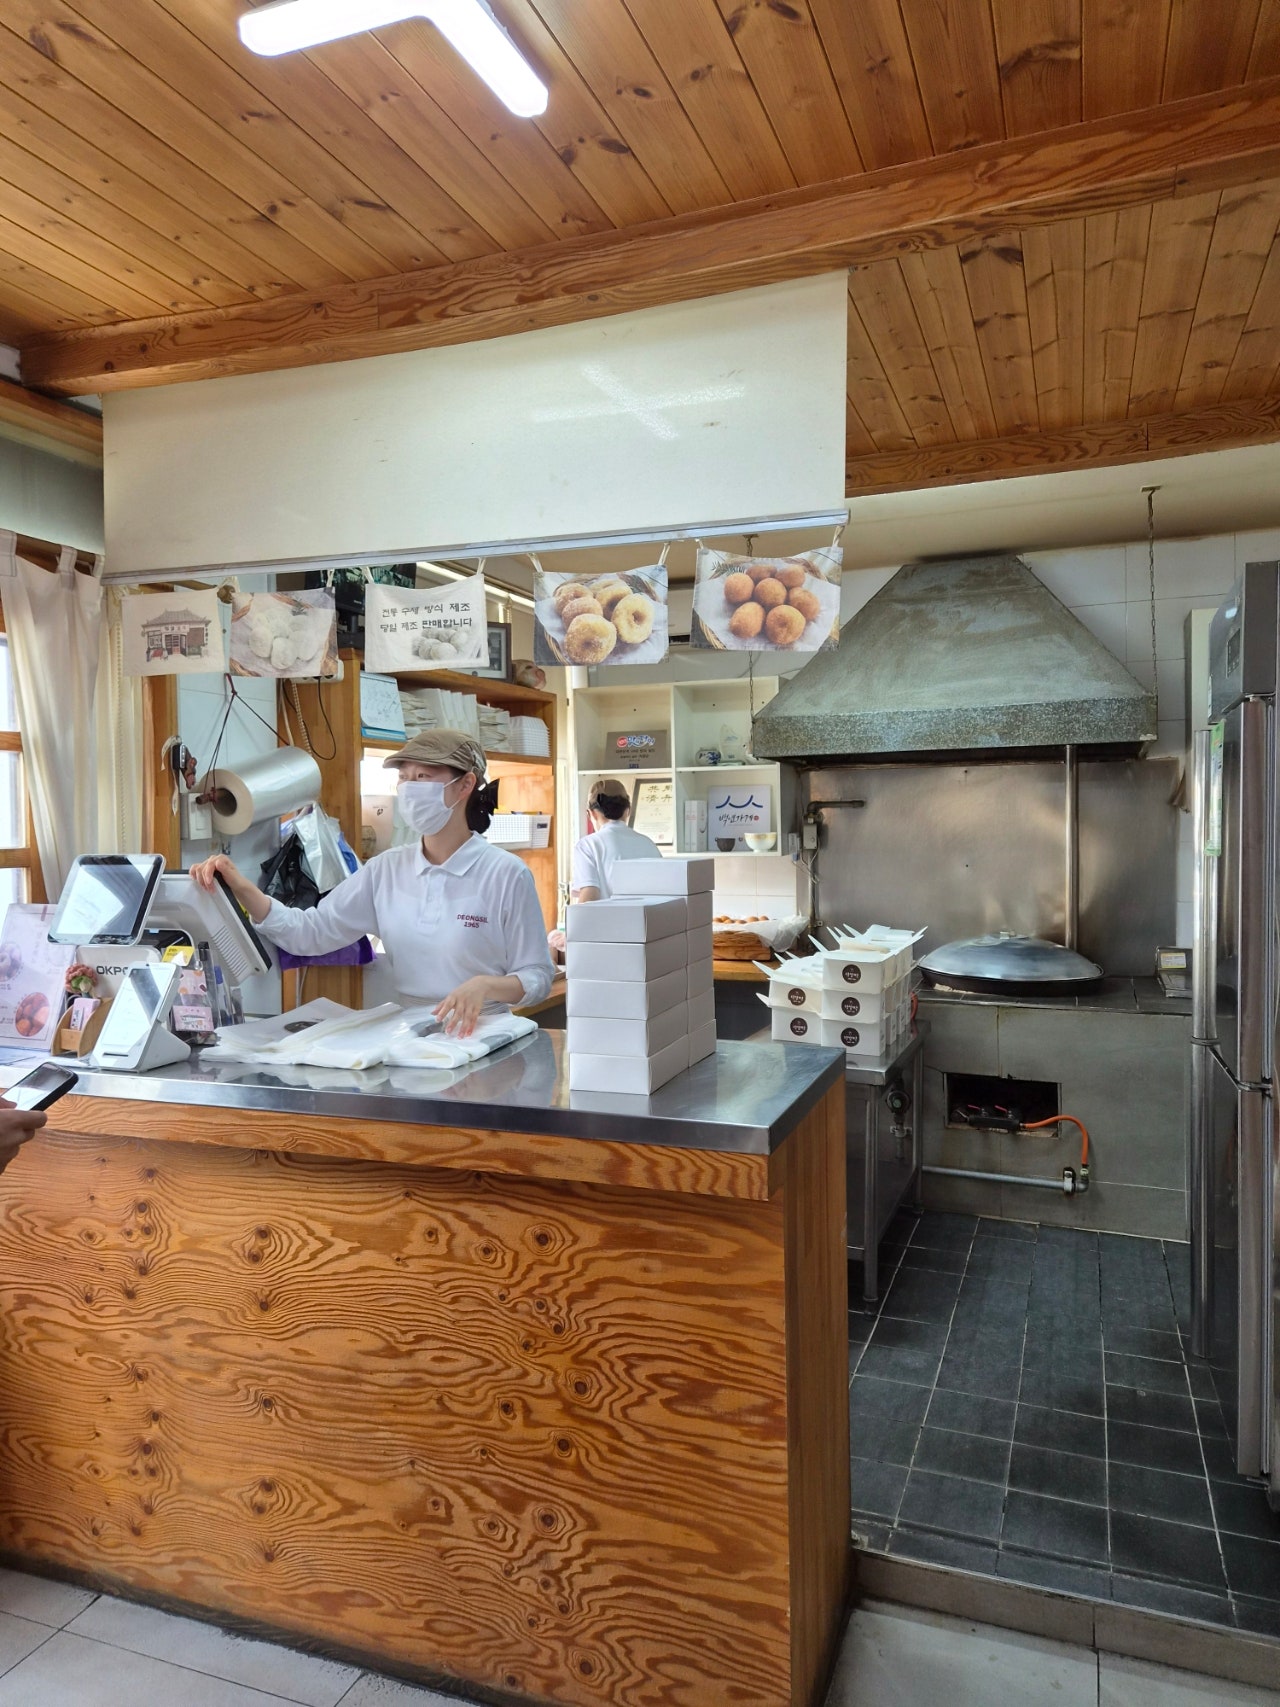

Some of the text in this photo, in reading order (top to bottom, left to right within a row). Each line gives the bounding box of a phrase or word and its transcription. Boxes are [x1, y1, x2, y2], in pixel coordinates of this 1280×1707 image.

[424, 604, 443, 613] 방식
[449, 602, 470, 612] 제조
[380, 617, 472, 633] 당일 제조 판매합니다
